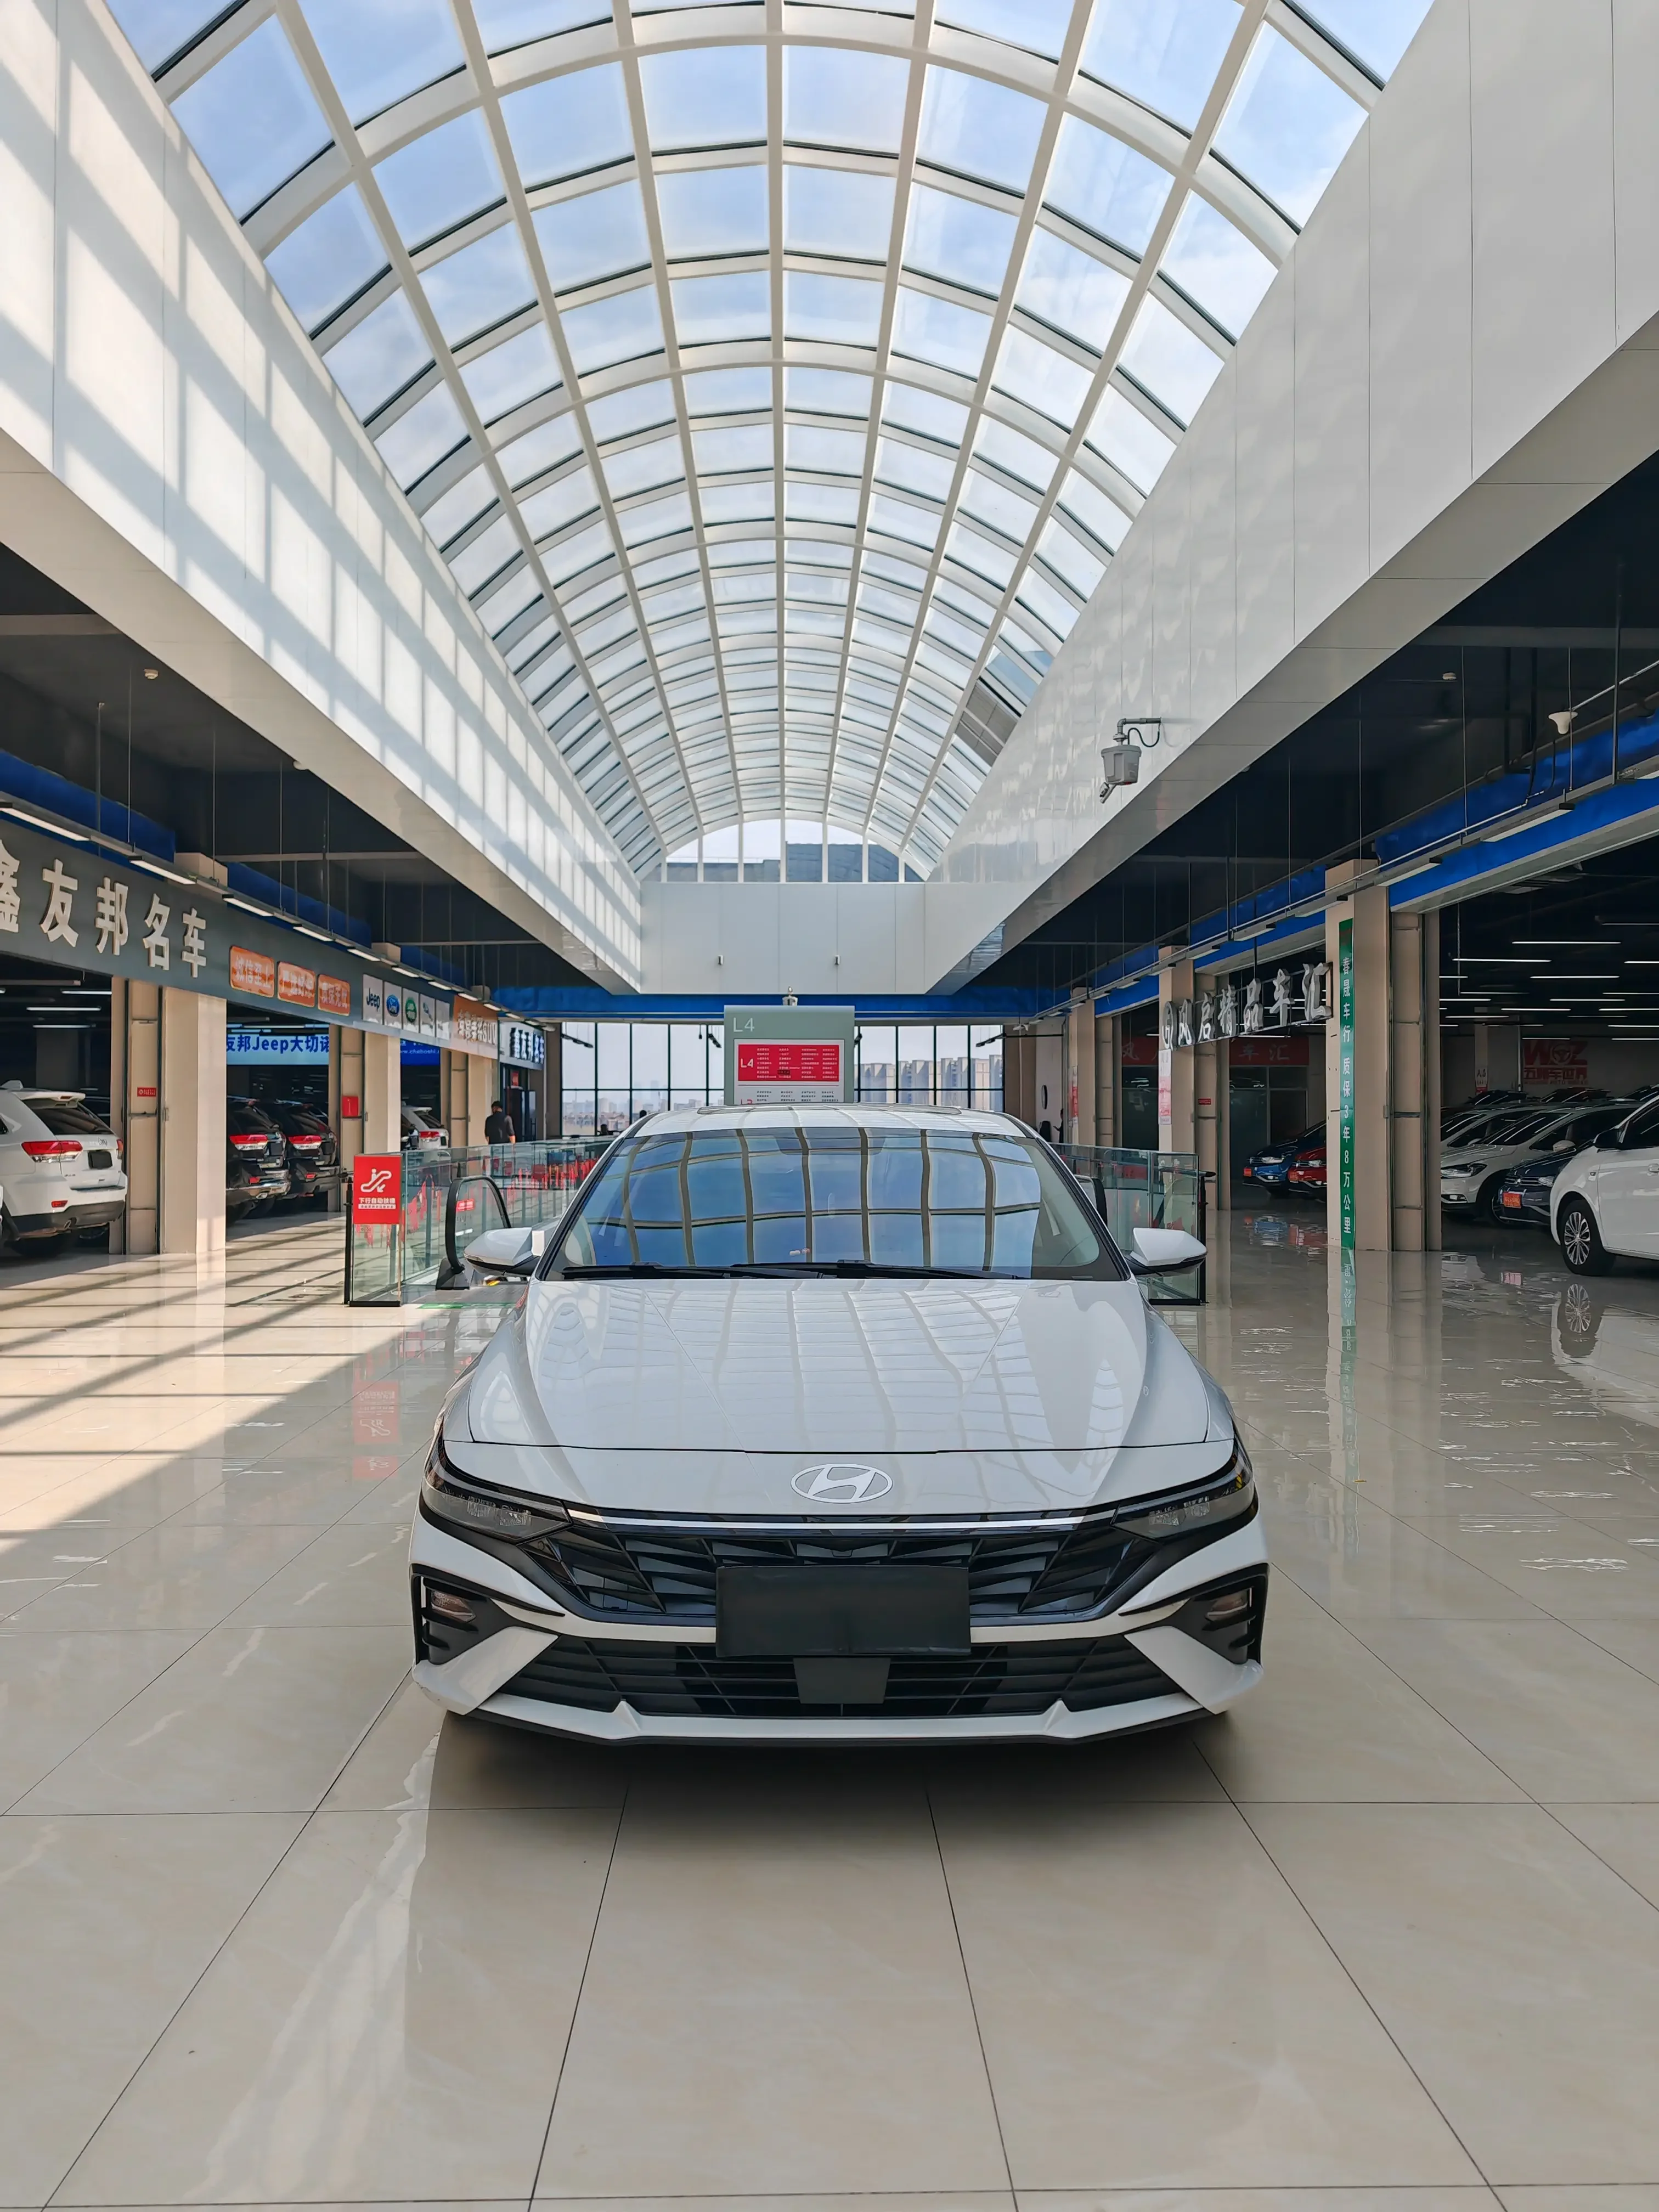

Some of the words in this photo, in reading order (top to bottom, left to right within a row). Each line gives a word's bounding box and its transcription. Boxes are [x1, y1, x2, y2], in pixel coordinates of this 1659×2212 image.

[366, 988, 380, 1012] Jeep
[1178, 962, 1333, 1046] 风启精品车汇
[1342, 957, 1351, 1042] 春晟车行
[733, 1017, 755, 1032] L4
[513, 1027, 544, 1064] 鑫友邦名车
[741, 1058, 754, 1068] L4
[1343, 1057, 1351, 1234] 质保3年8万公里
